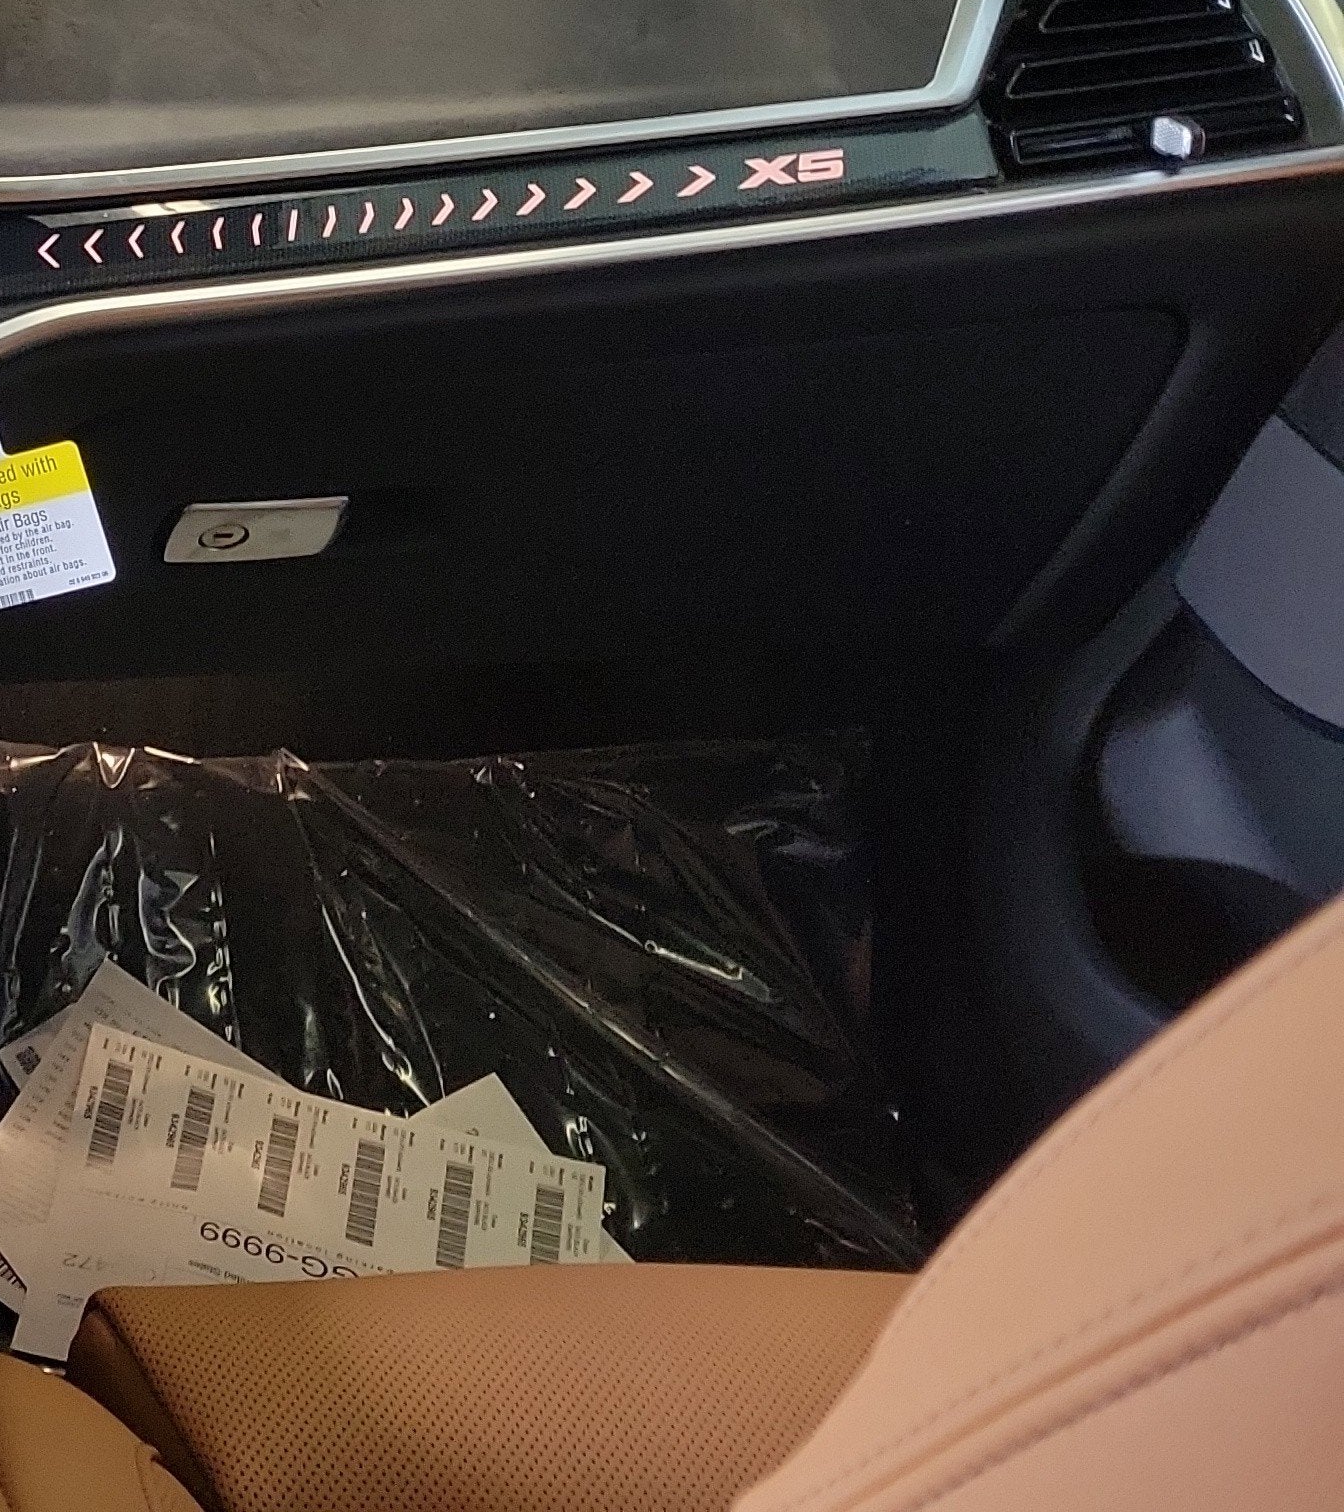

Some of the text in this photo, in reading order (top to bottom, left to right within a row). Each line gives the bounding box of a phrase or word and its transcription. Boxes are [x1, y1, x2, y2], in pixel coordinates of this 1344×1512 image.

[737, 148, 844, 189] X5
[20, 453, 57, 477] with
[11, 530, 23, 541] by
[24, 526, 39, 537] the
[40, 522, 52, 533] air
[54, 517, 74, 529] bag.
[12, 506, 48, 528] Bags
[0, 543, 12, 553] for
[14, 532, 53, 550] children.
[5, 553, 14, 562] in
[15, 549, 30, 560] the
[31, 542, 56, 556] front.
[21, 565, 47, 580] about
[48, 562, 60, 573] air
[62, 555, 87, 570] bags.
